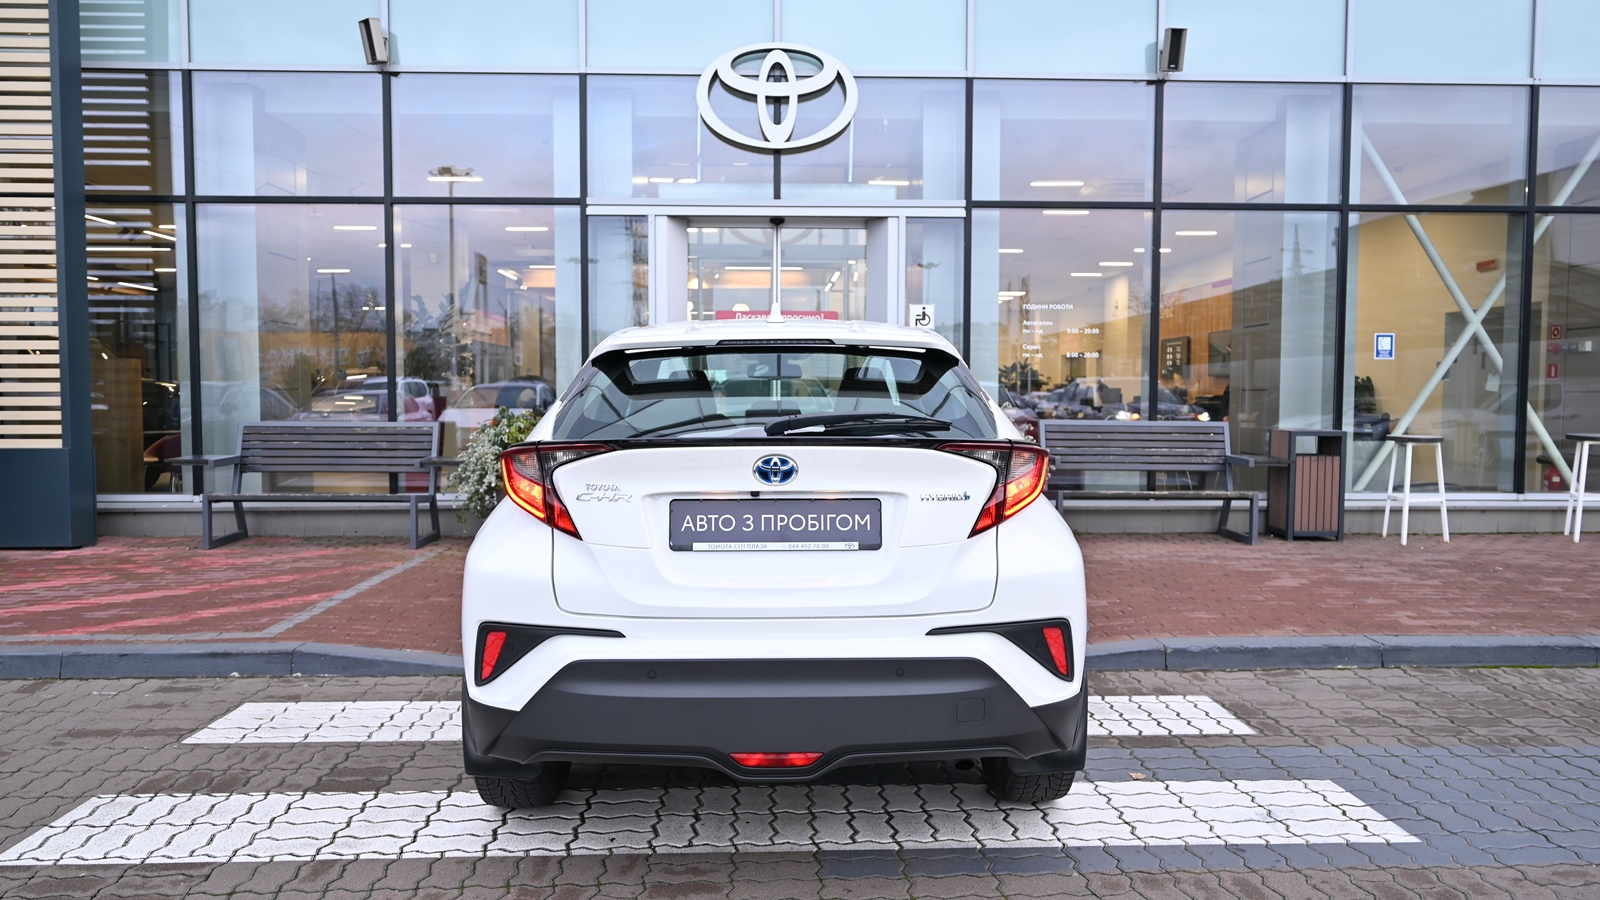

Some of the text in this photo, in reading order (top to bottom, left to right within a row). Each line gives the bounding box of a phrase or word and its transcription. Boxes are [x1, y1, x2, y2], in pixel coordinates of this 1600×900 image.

[585, 483, 621, 491] TOYOTA
[575, 492, 633, 503] C-HR
[919, 493, 964, 502] HYBRID
[681, 514, 736, 532] АВТО
[761, 514, 871, 532] ПРОБІГОМ
